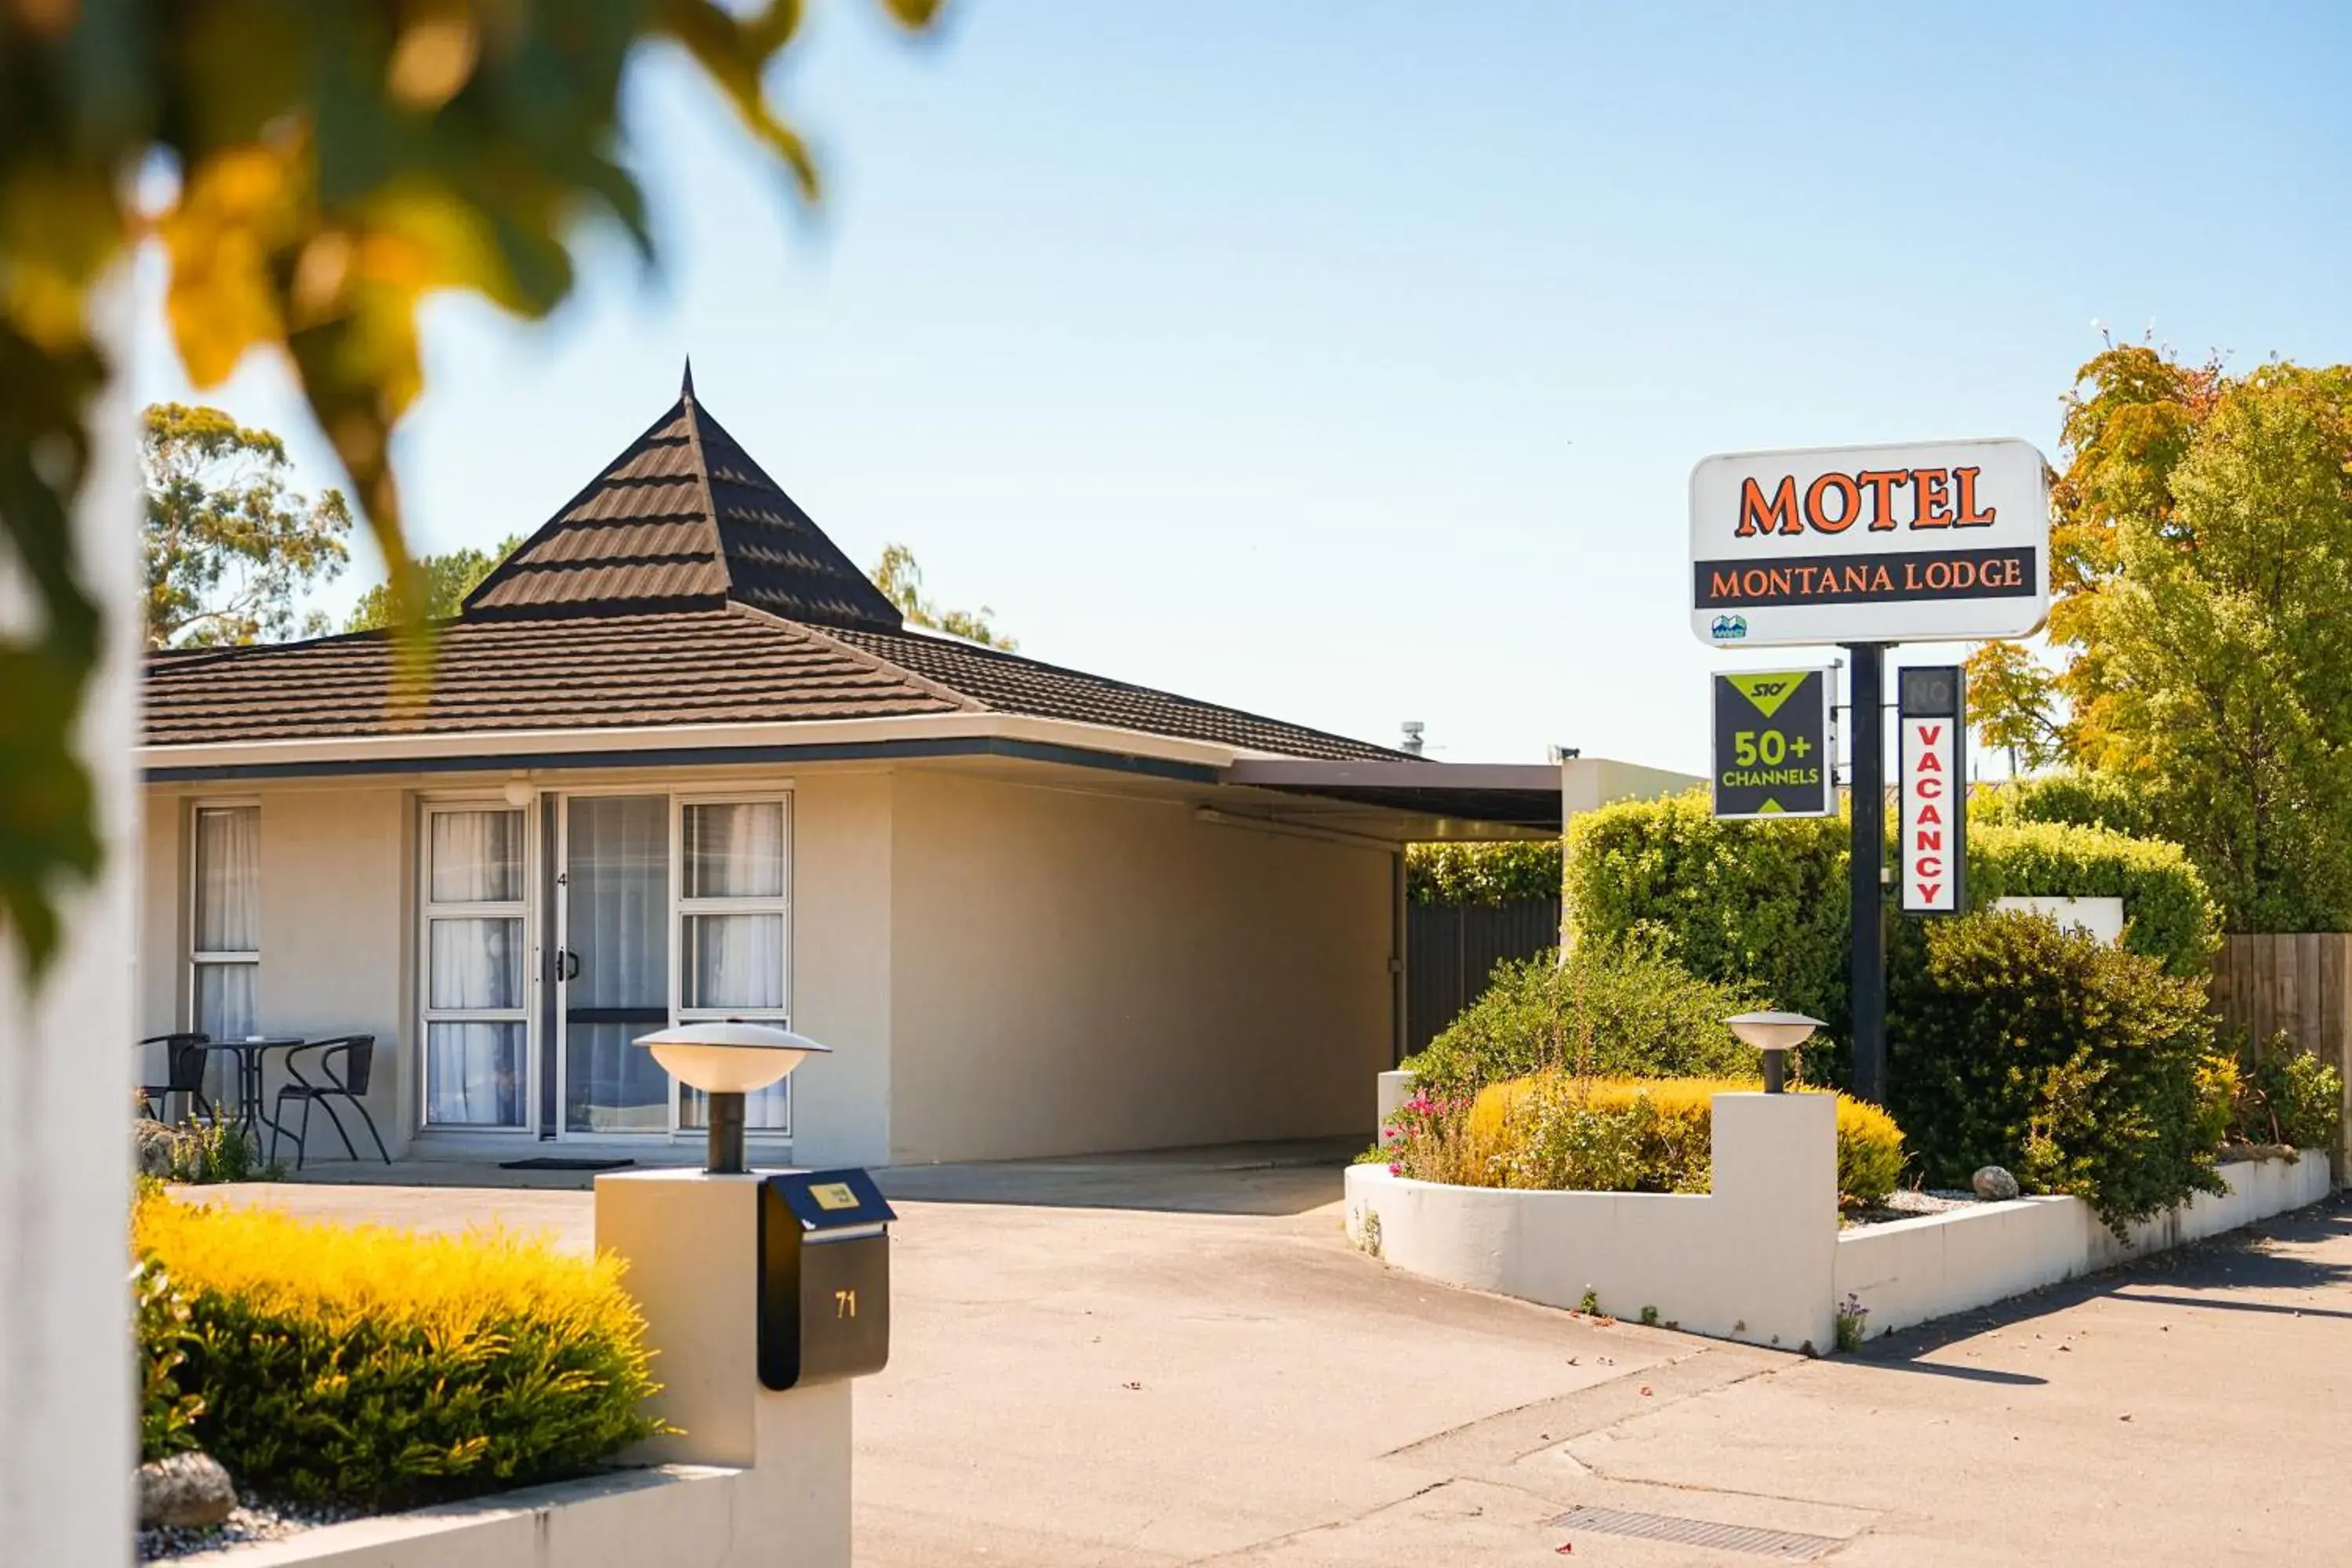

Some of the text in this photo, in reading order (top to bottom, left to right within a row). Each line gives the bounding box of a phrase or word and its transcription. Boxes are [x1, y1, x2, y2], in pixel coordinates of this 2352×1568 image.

[1735, 466, 1996, 537] MOTEL
[1710, 560, 2023, 598] MONTANA LODGE
[1910, 679, 1950, 703] NO
[1734, 730, 1812, 766] 50+
[1722, 768, 1819, 786] CHANNELS
[1915, 726, 1942, 903] VACANCY
[557, 873, 567, 887] 4
[835, 1290, 856, 1318] 71
